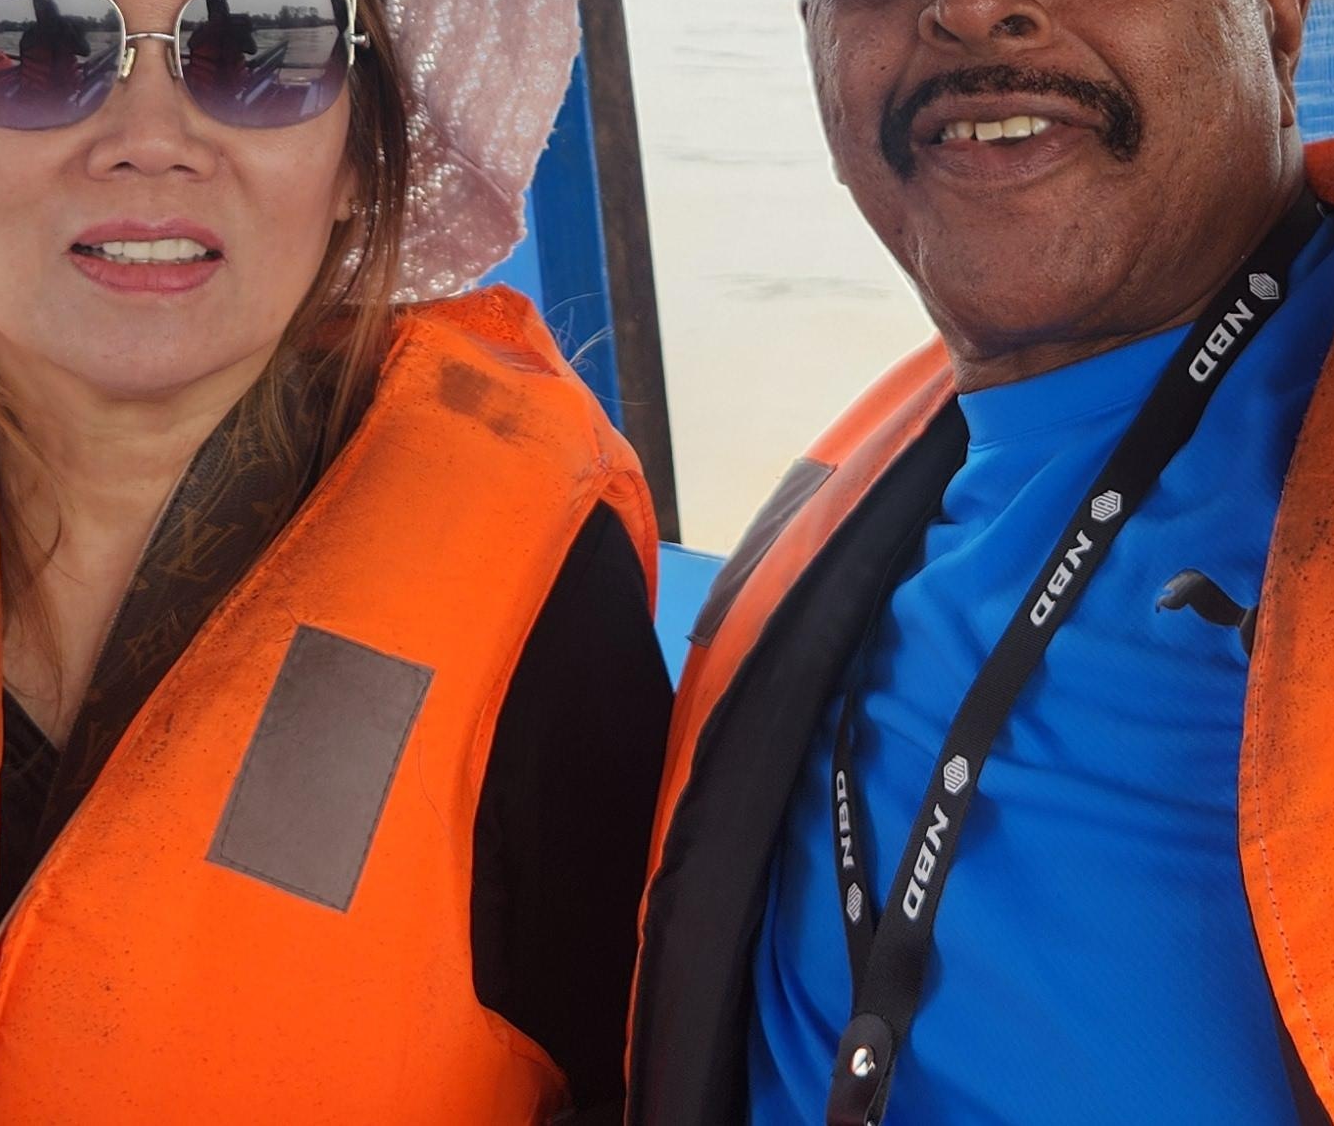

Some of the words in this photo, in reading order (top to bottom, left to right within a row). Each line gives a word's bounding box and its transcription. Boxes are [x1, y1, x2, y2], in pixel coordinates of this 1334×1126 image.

[1188, 298, 1256, 383] NBD
[1029, 529, 1094, 627] NBD
[835, 769, 855, 869] NBD
[901, 803, 950, 921] NBD
